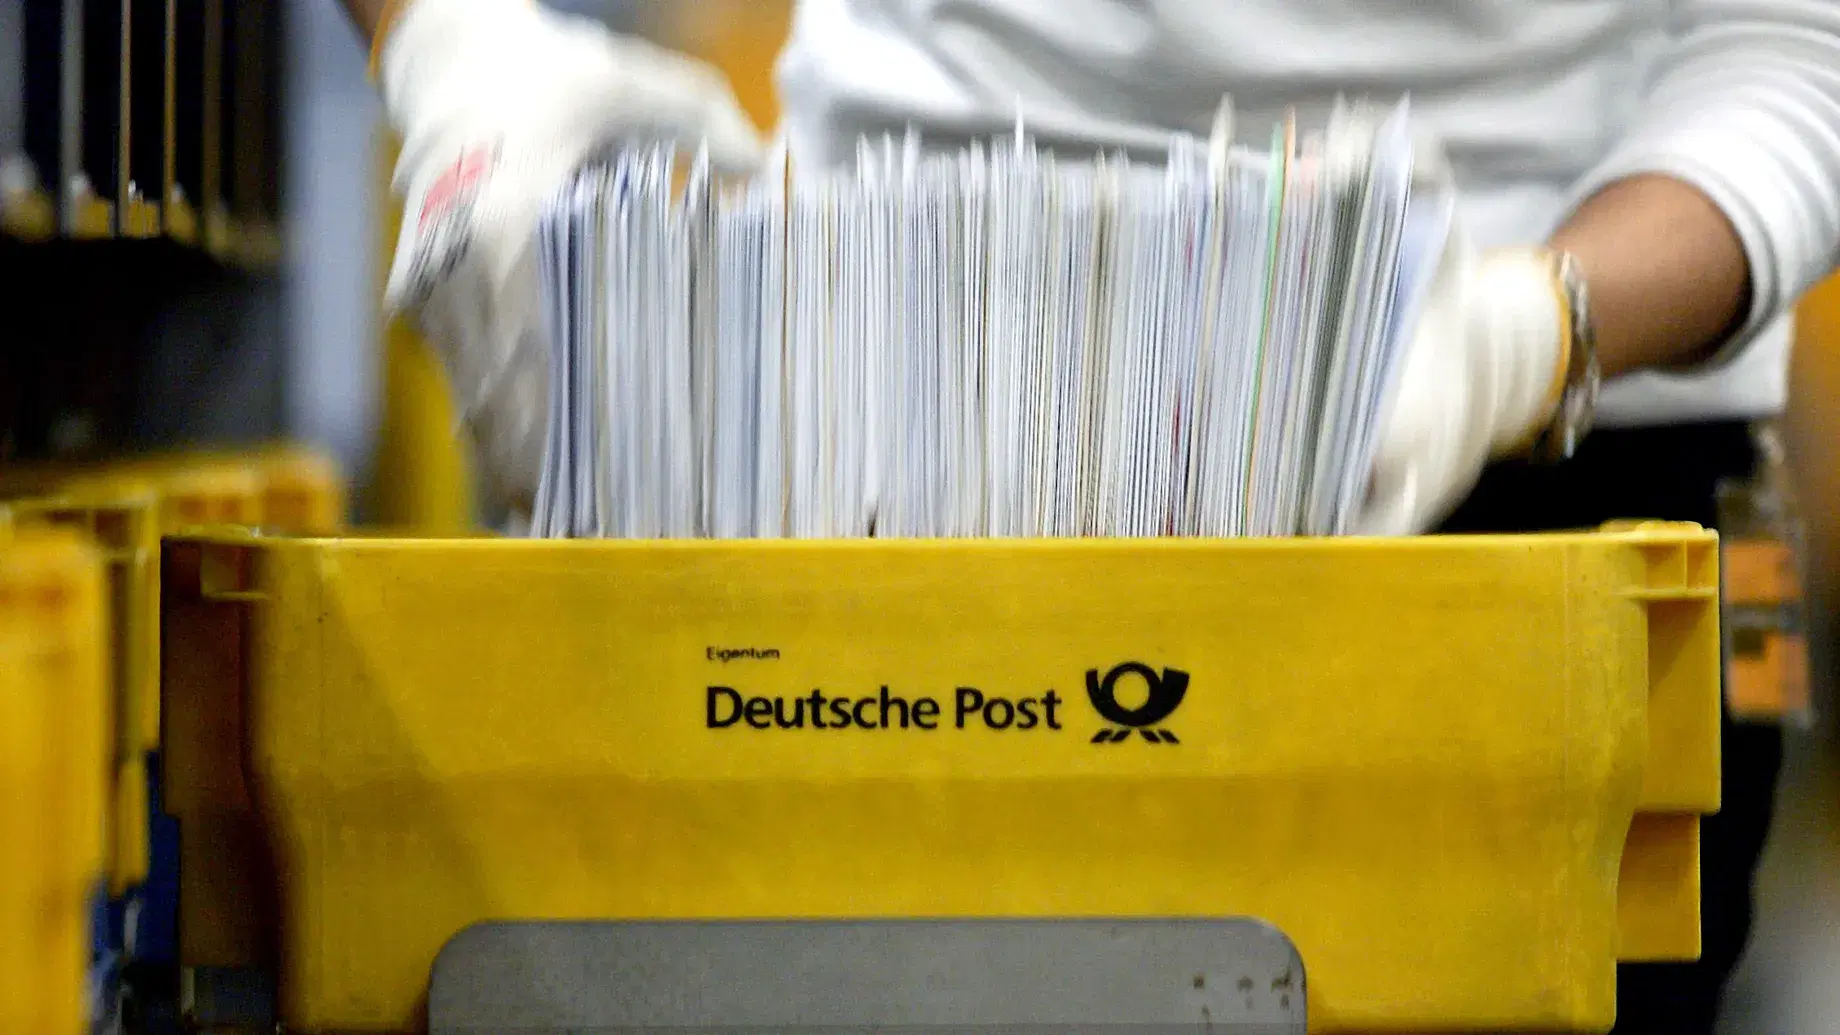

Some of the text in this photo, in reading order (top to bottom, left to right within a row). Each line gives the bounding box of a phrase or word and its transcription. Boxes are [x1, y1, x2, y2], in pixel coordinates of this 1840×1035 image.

[706, 646, 780, 663] Eigentum
[706, 685, 1063, 731] Deutsche Post
